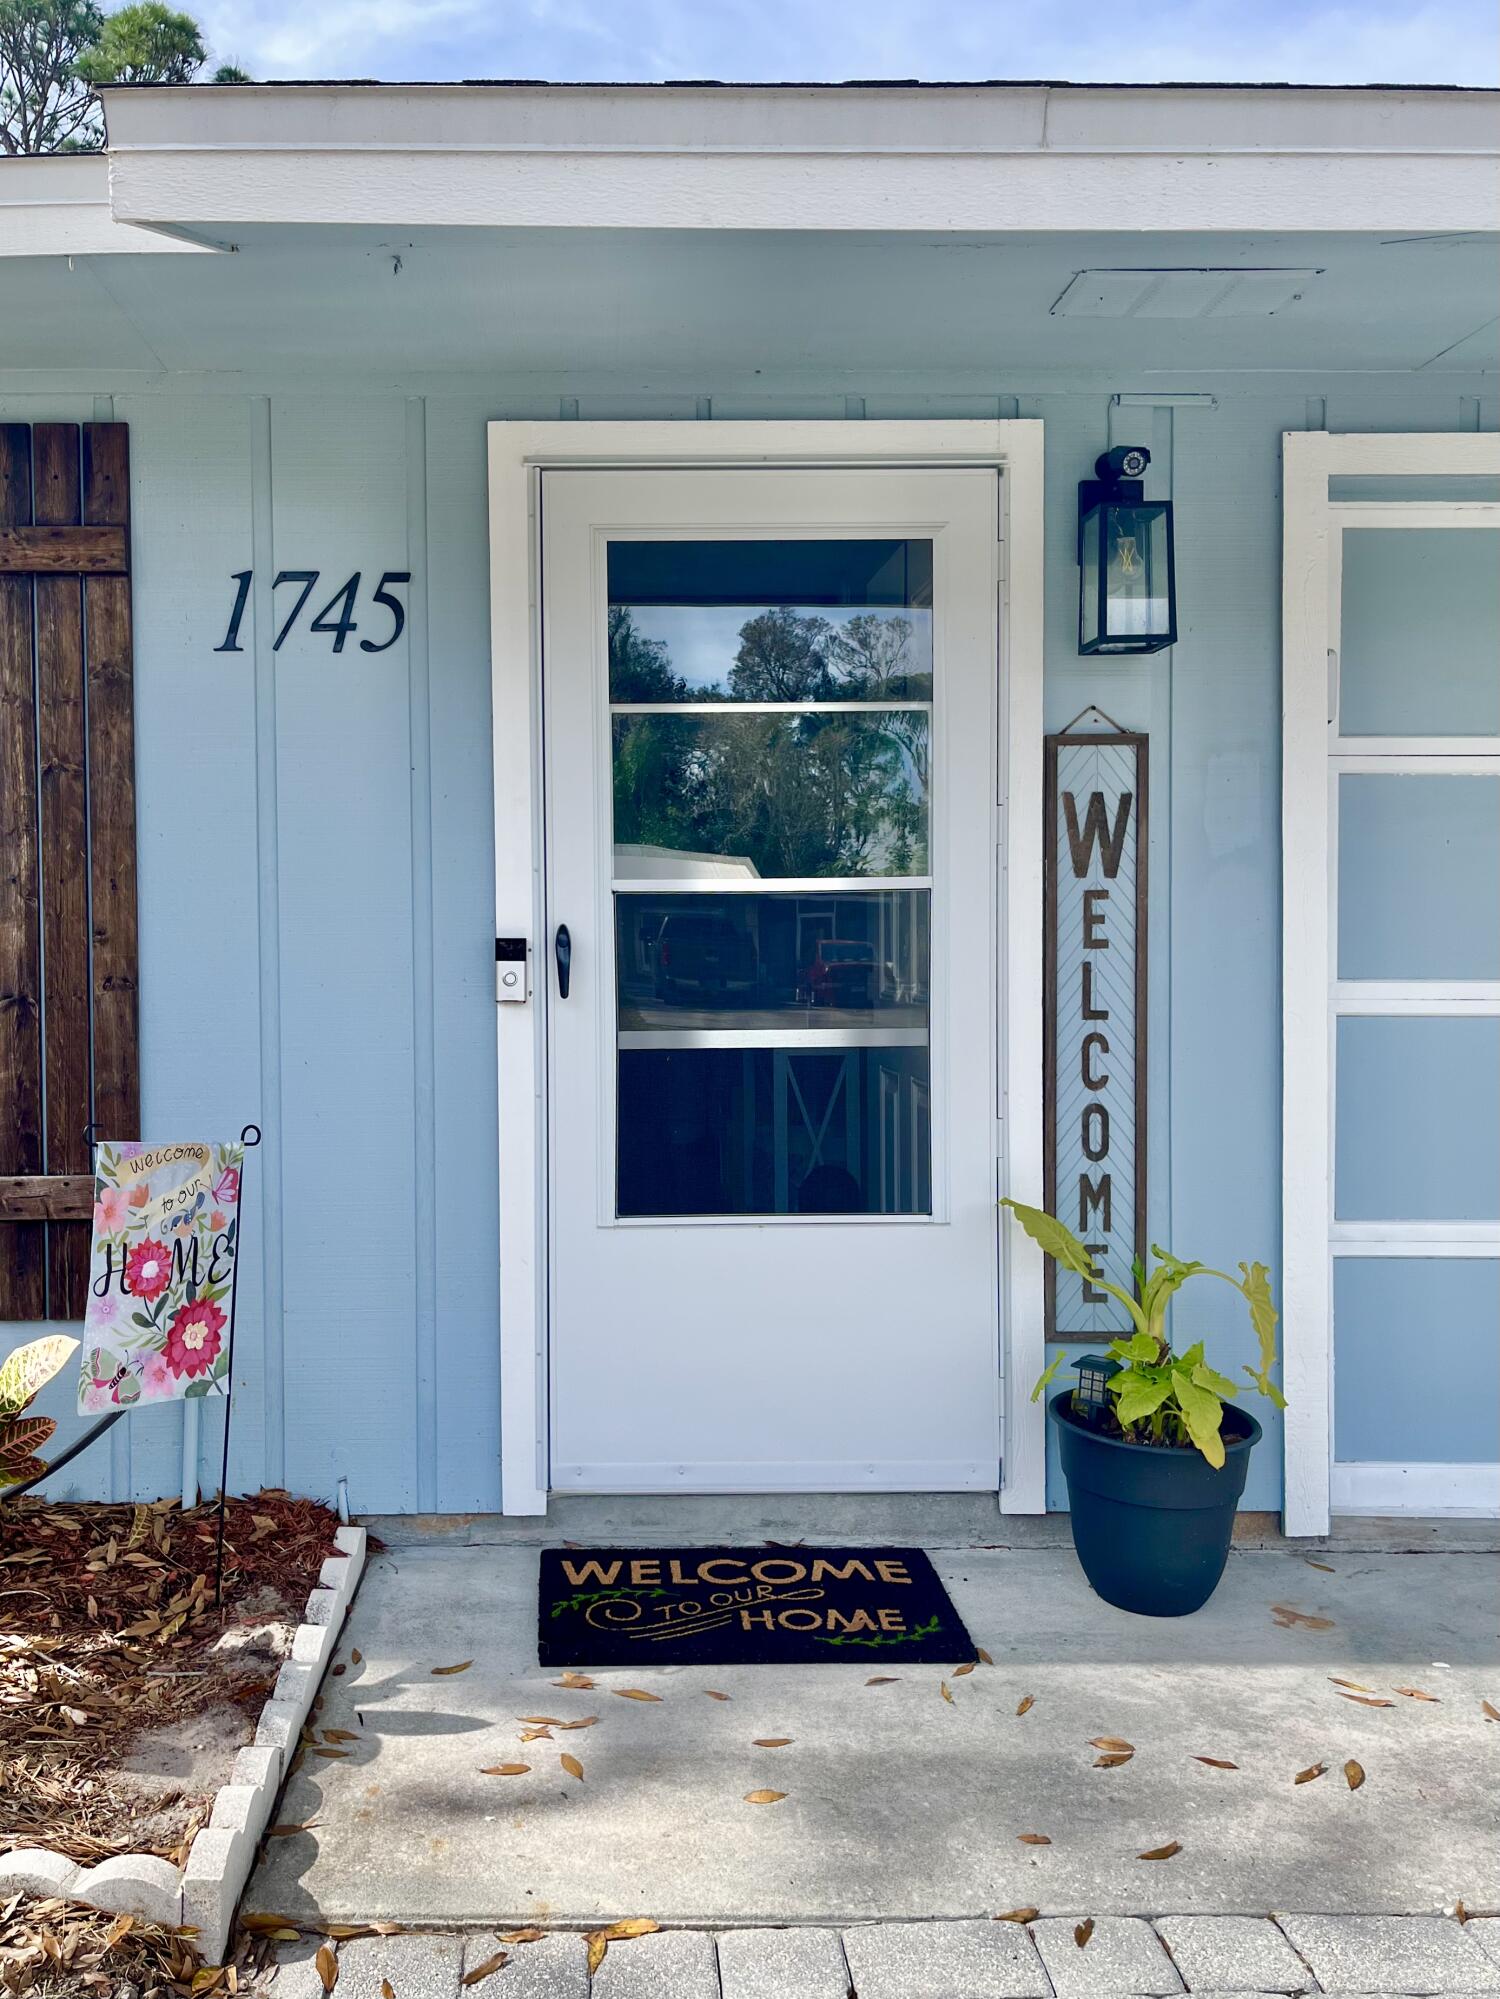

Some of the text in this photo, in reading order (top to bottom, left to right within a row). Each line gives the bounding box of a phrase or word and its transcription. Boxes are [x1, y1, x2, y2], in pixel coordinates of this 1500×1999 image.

[213, 570, 411, 653] 1745
[1061, 791, 1133, 1303] WELCOME
[161, 1178, 201, 1214] to our
[560, 1558, 913, 1585] WELCOME
[653, 1585, 776, 1620] TO OUR
[740, 1608, 908, 1633] HOME
